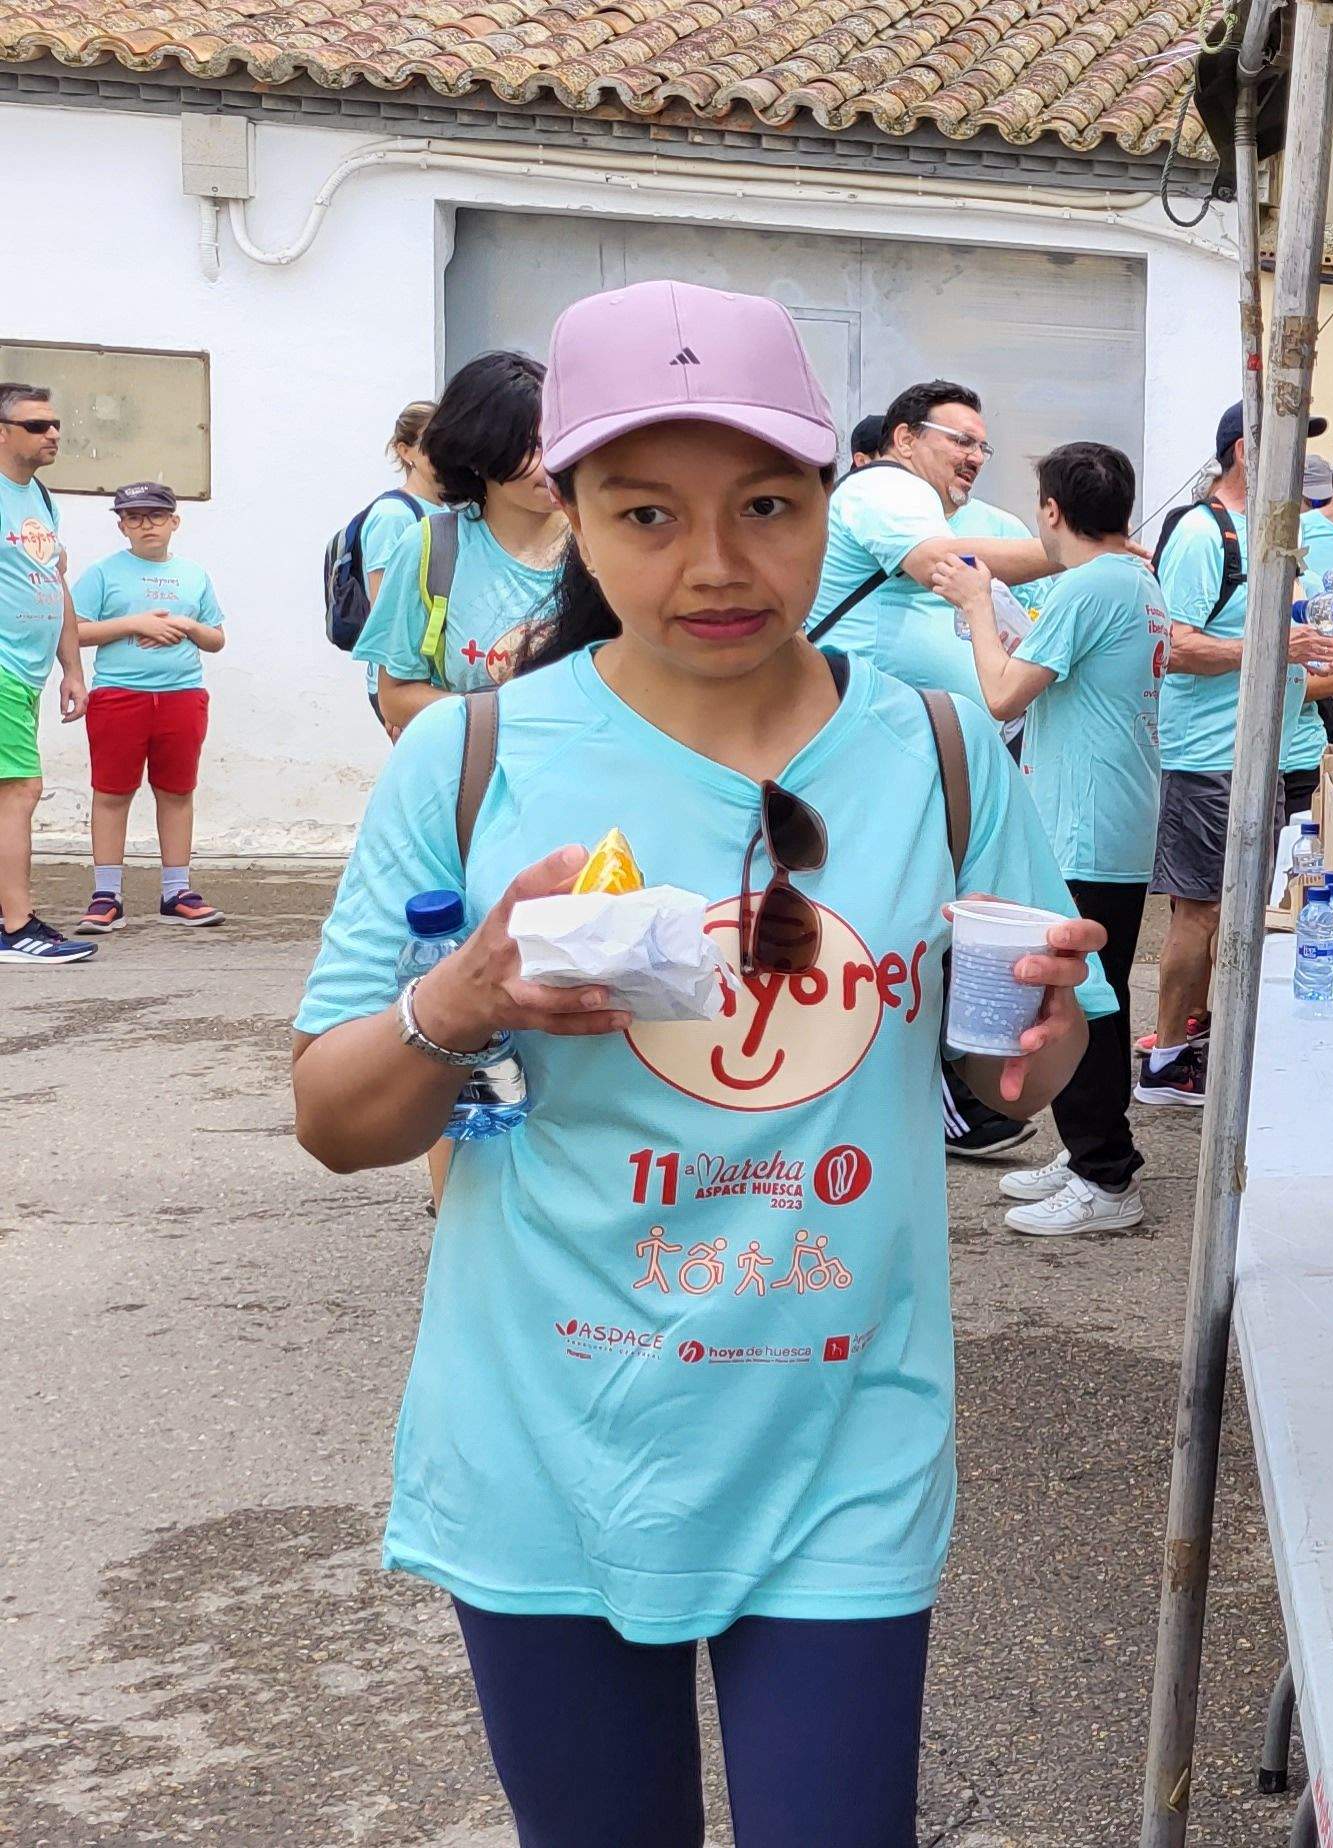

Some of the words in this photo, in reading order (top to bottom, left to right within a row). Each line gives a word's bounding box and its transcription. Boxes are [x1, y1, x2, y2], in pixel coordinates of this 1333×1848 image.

[697, 1150, 806, 1186] Marcha
[695, 1184, 747, 1200] ASPACE
[752, 1183, 804, 1197] HUESCA
[770, 1198, 803, 1210] 2023
[579, 1322, 665, 1349] ASPACE
[709, 1345, 743, 1359] hoya
[745, 1345, 763, 1356] de
[765, 1345, 812, 1356] huesca
